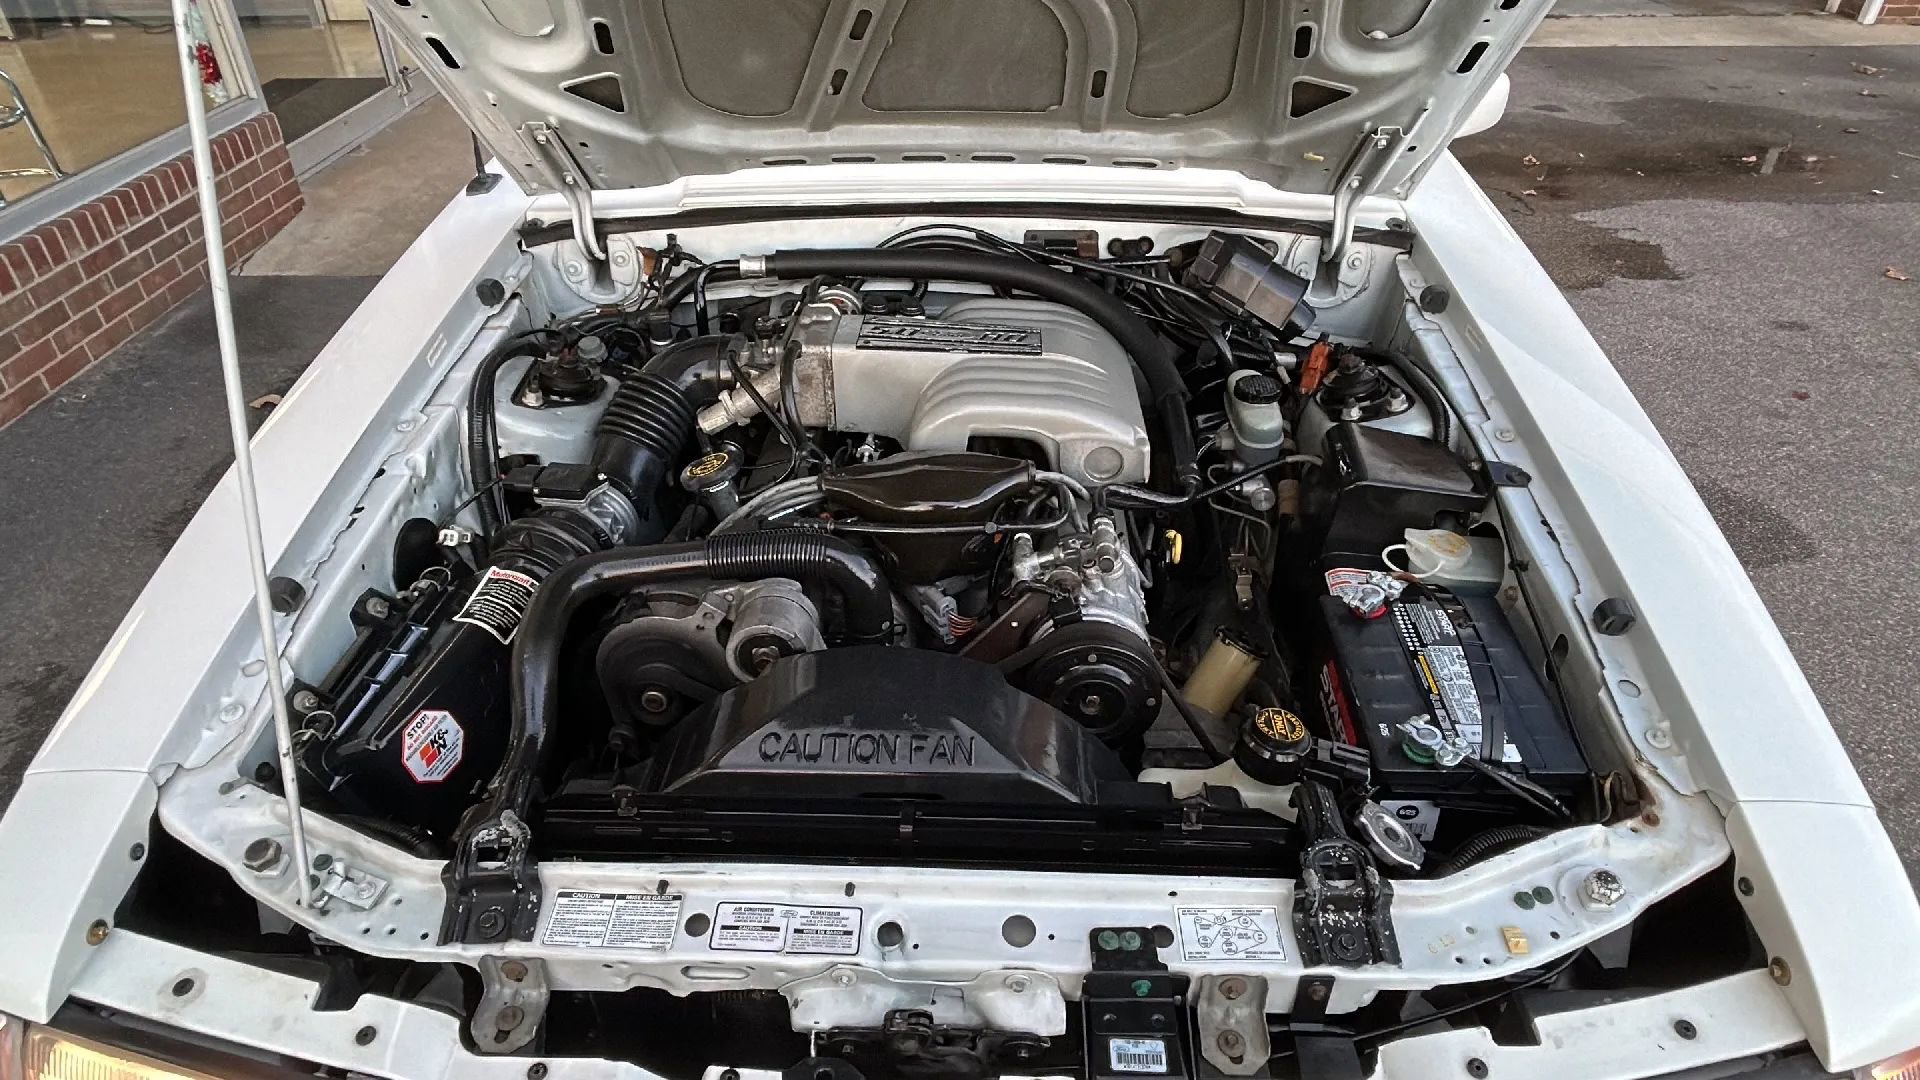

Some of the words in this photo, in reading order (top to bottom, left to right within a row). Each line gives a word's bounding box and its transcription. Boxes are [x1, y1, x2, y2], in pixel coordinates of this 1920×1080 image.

[1273, 714, 1287, 736] ONLY
[758, 732, 900, 765] CAUTION
[909, 734, 975, 767] FAN
